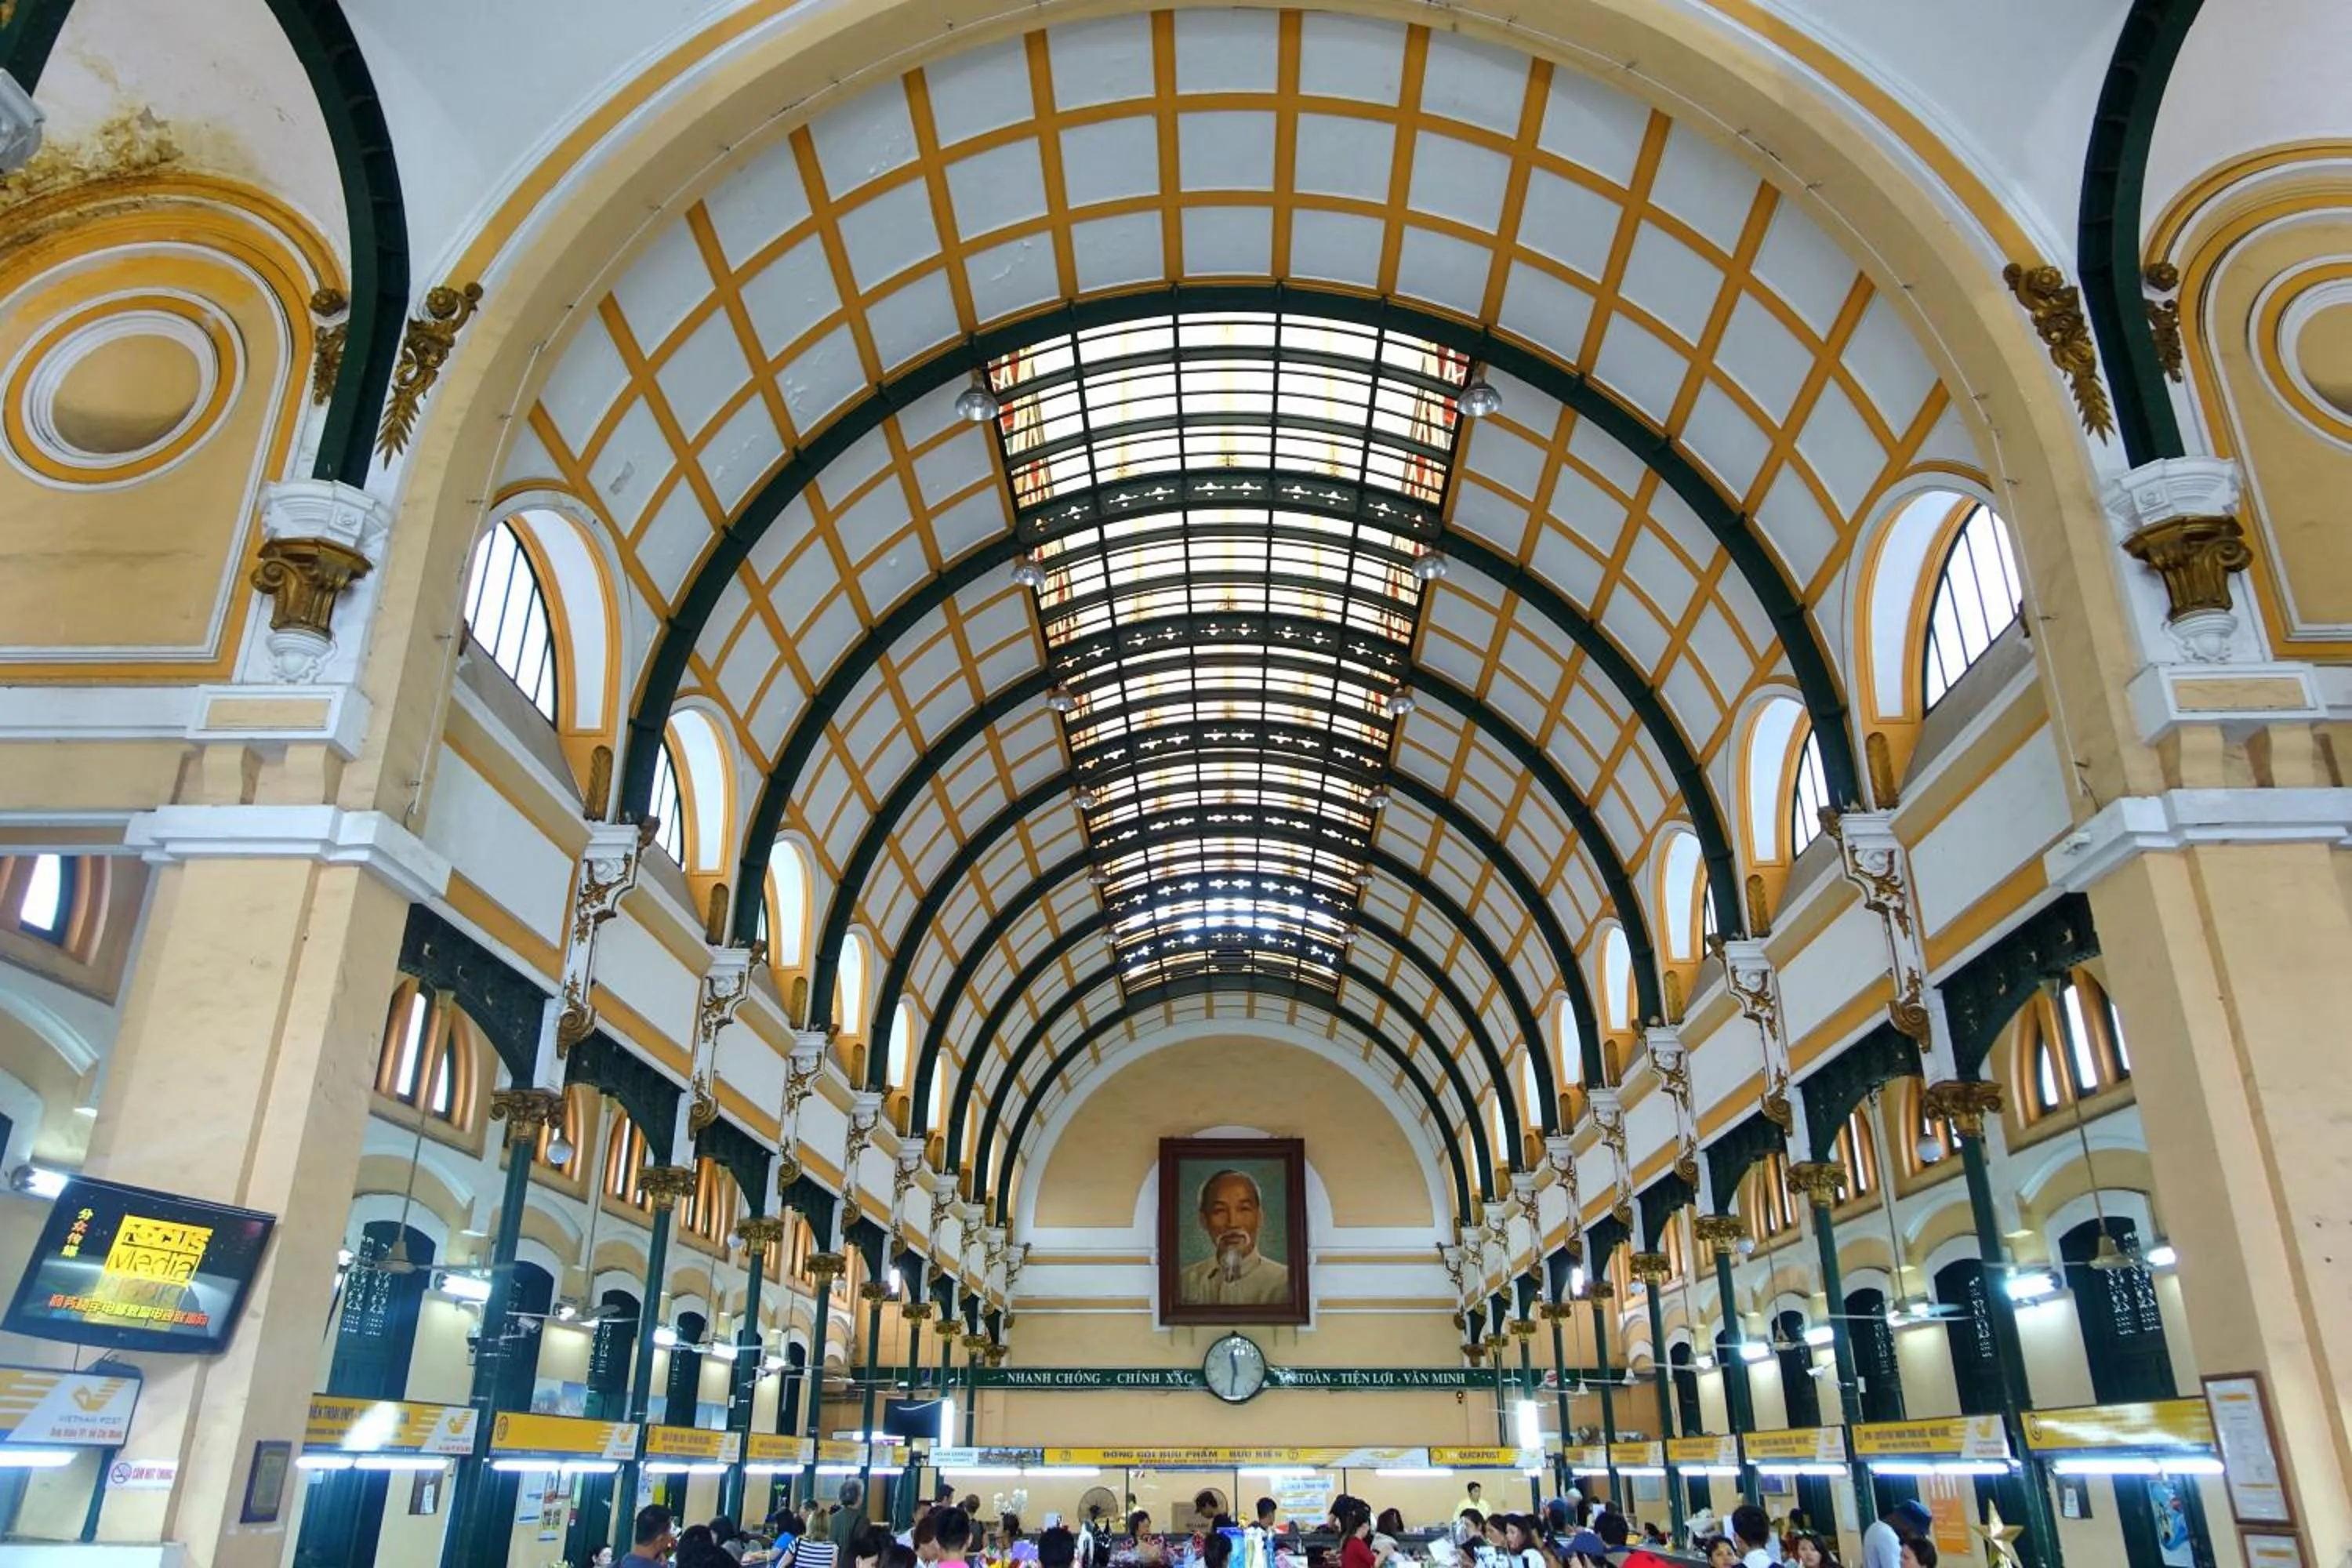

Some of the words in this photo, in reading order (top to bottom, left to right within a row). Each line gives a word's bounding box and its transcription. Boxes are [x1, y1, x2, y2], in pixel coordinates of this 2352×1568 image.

[107, 1245, 196, 1283] Media
[1007, 1373, 1051, 1384] NHANH
[1116, 1369, 1160, 1384] CHÍNH
[1298, 1370, 1331, 1384] TOÀN
[1341, 1370, 1370, 1386] TIỆN
[1432, 1373, 1465, 1384] MINH
